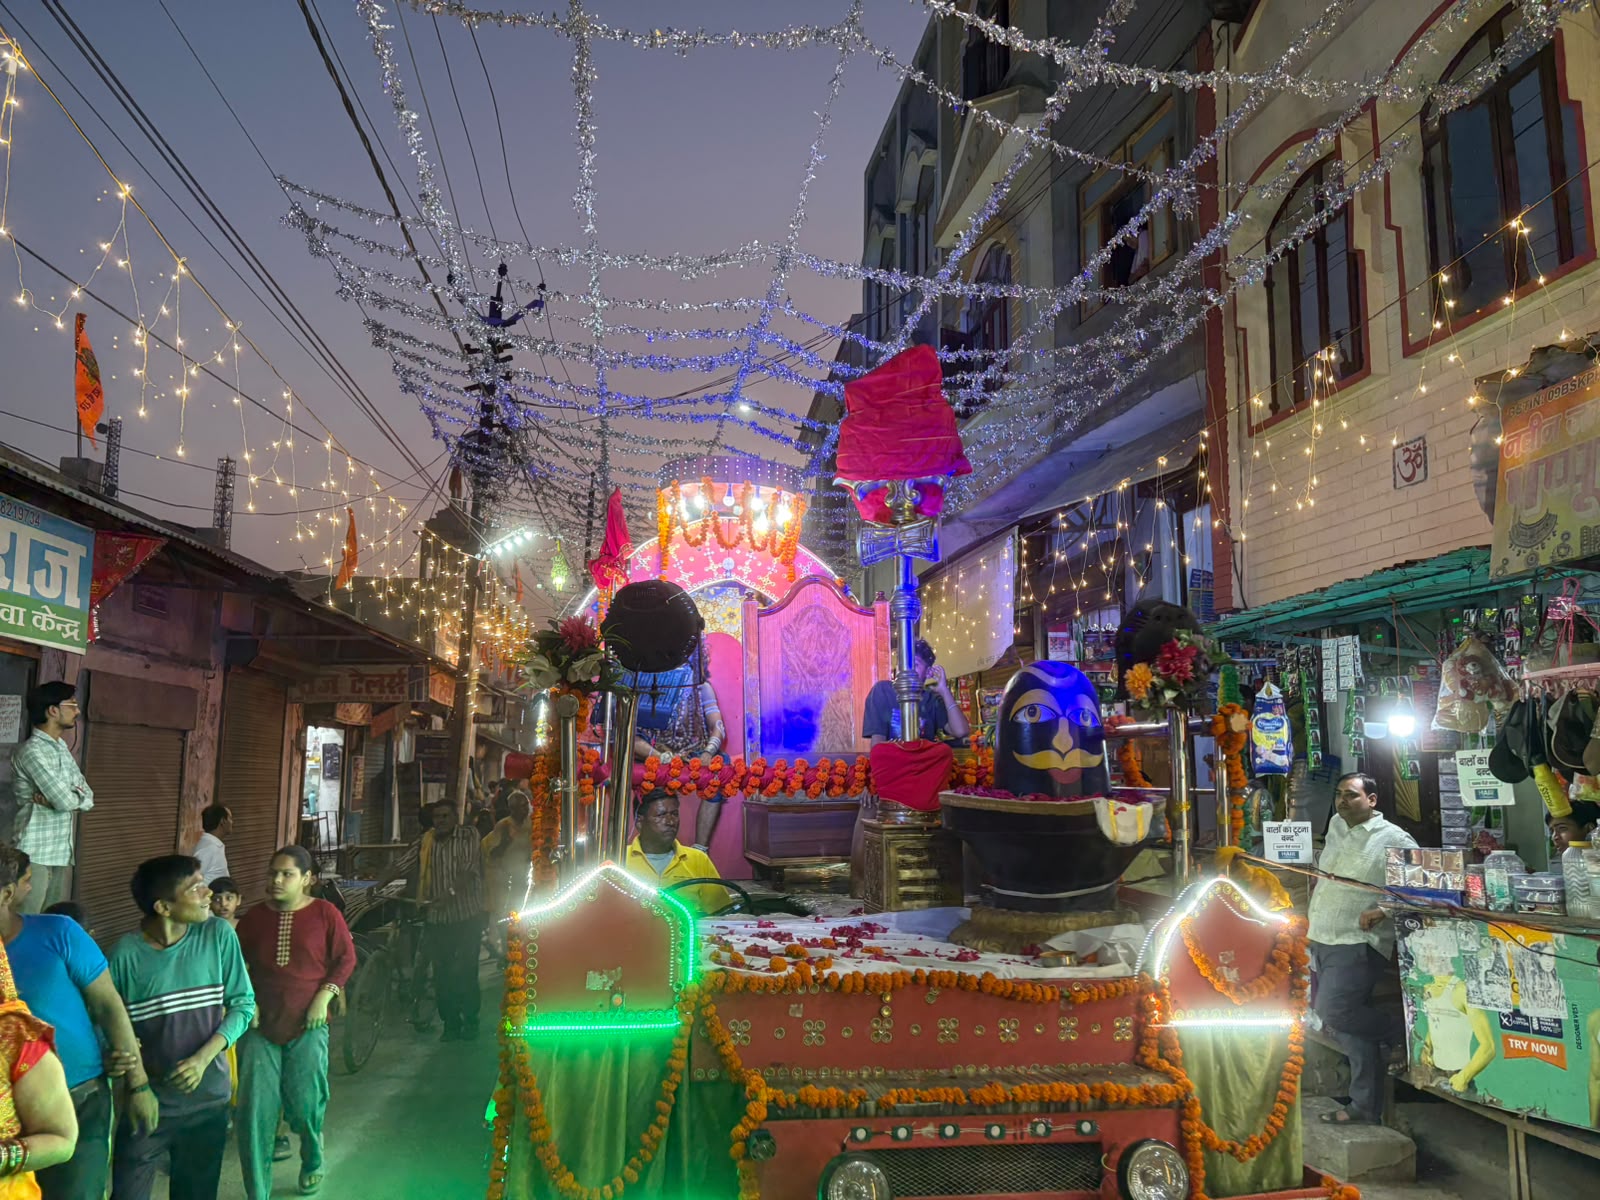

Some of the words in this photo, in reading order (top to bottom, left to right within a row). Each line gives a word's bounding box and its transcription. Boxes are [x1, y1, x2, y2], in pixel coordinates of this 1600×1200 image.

[31, 604, 81, 642] केन्द्र
[1508, 1038, 1528, 1051] TRY
[1531, 1042, 1558, 1056] NOW
